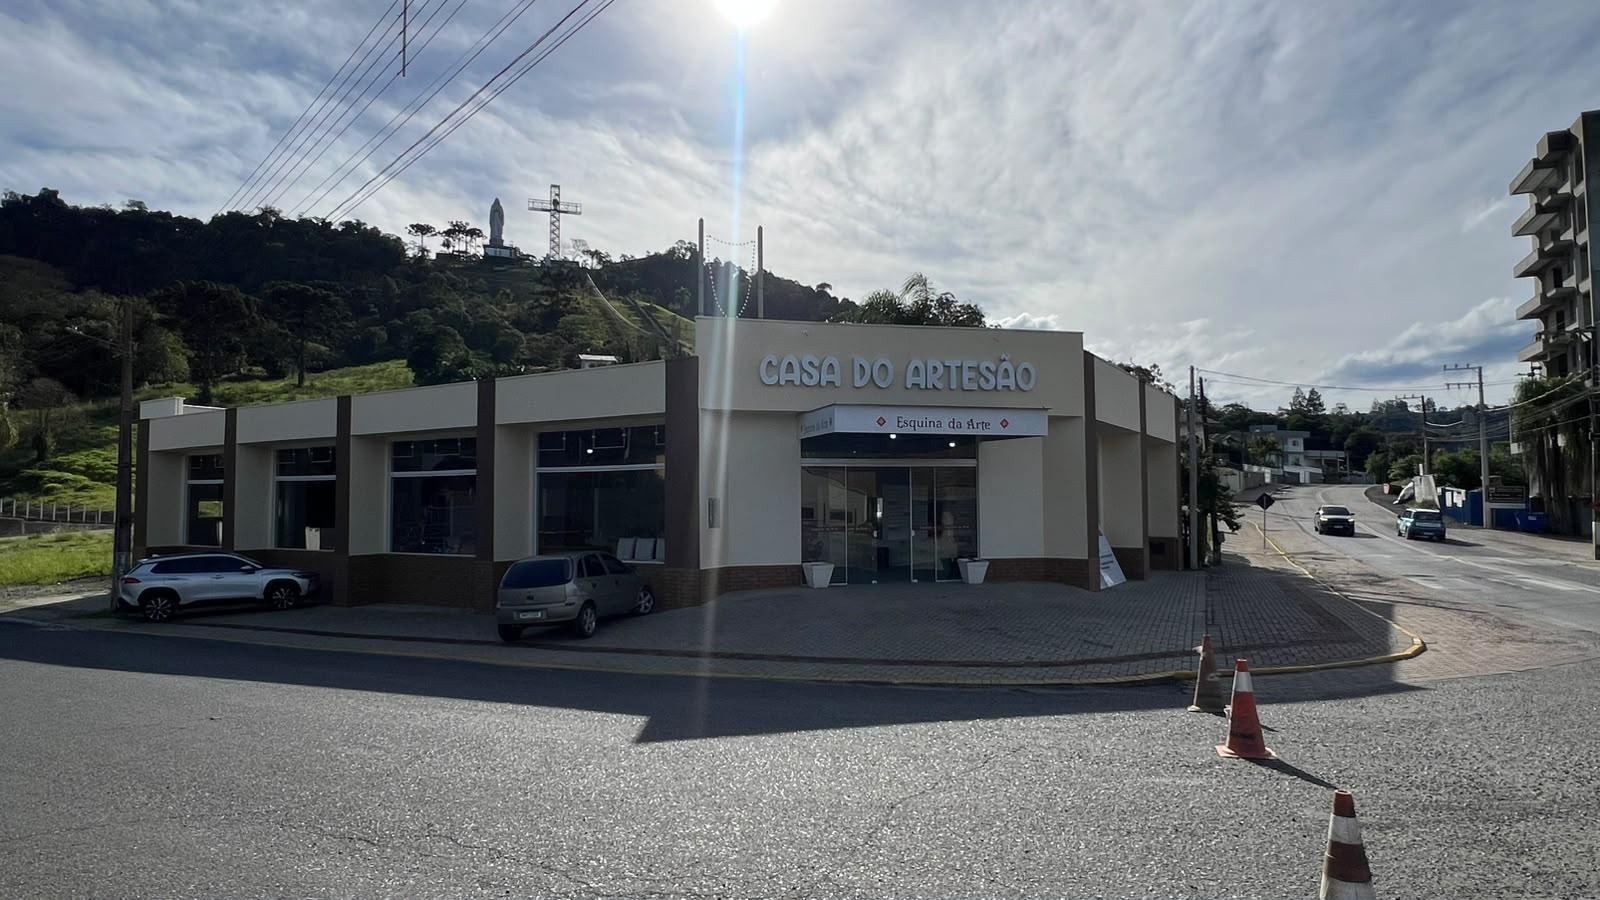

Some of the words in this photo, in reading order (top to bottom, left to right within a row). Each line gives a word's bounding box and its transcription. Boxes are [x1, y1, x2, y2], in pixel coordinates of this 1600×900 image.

[759, 354, 841, 388] CASA
[853, 356, 895, 389] DO
[904, 352, 1037, 392] ARTESÃO
[897, 416, 943, 431] Esquina
[948, 417, 962, 430] da
[967, 417, 991, 431] Arte
